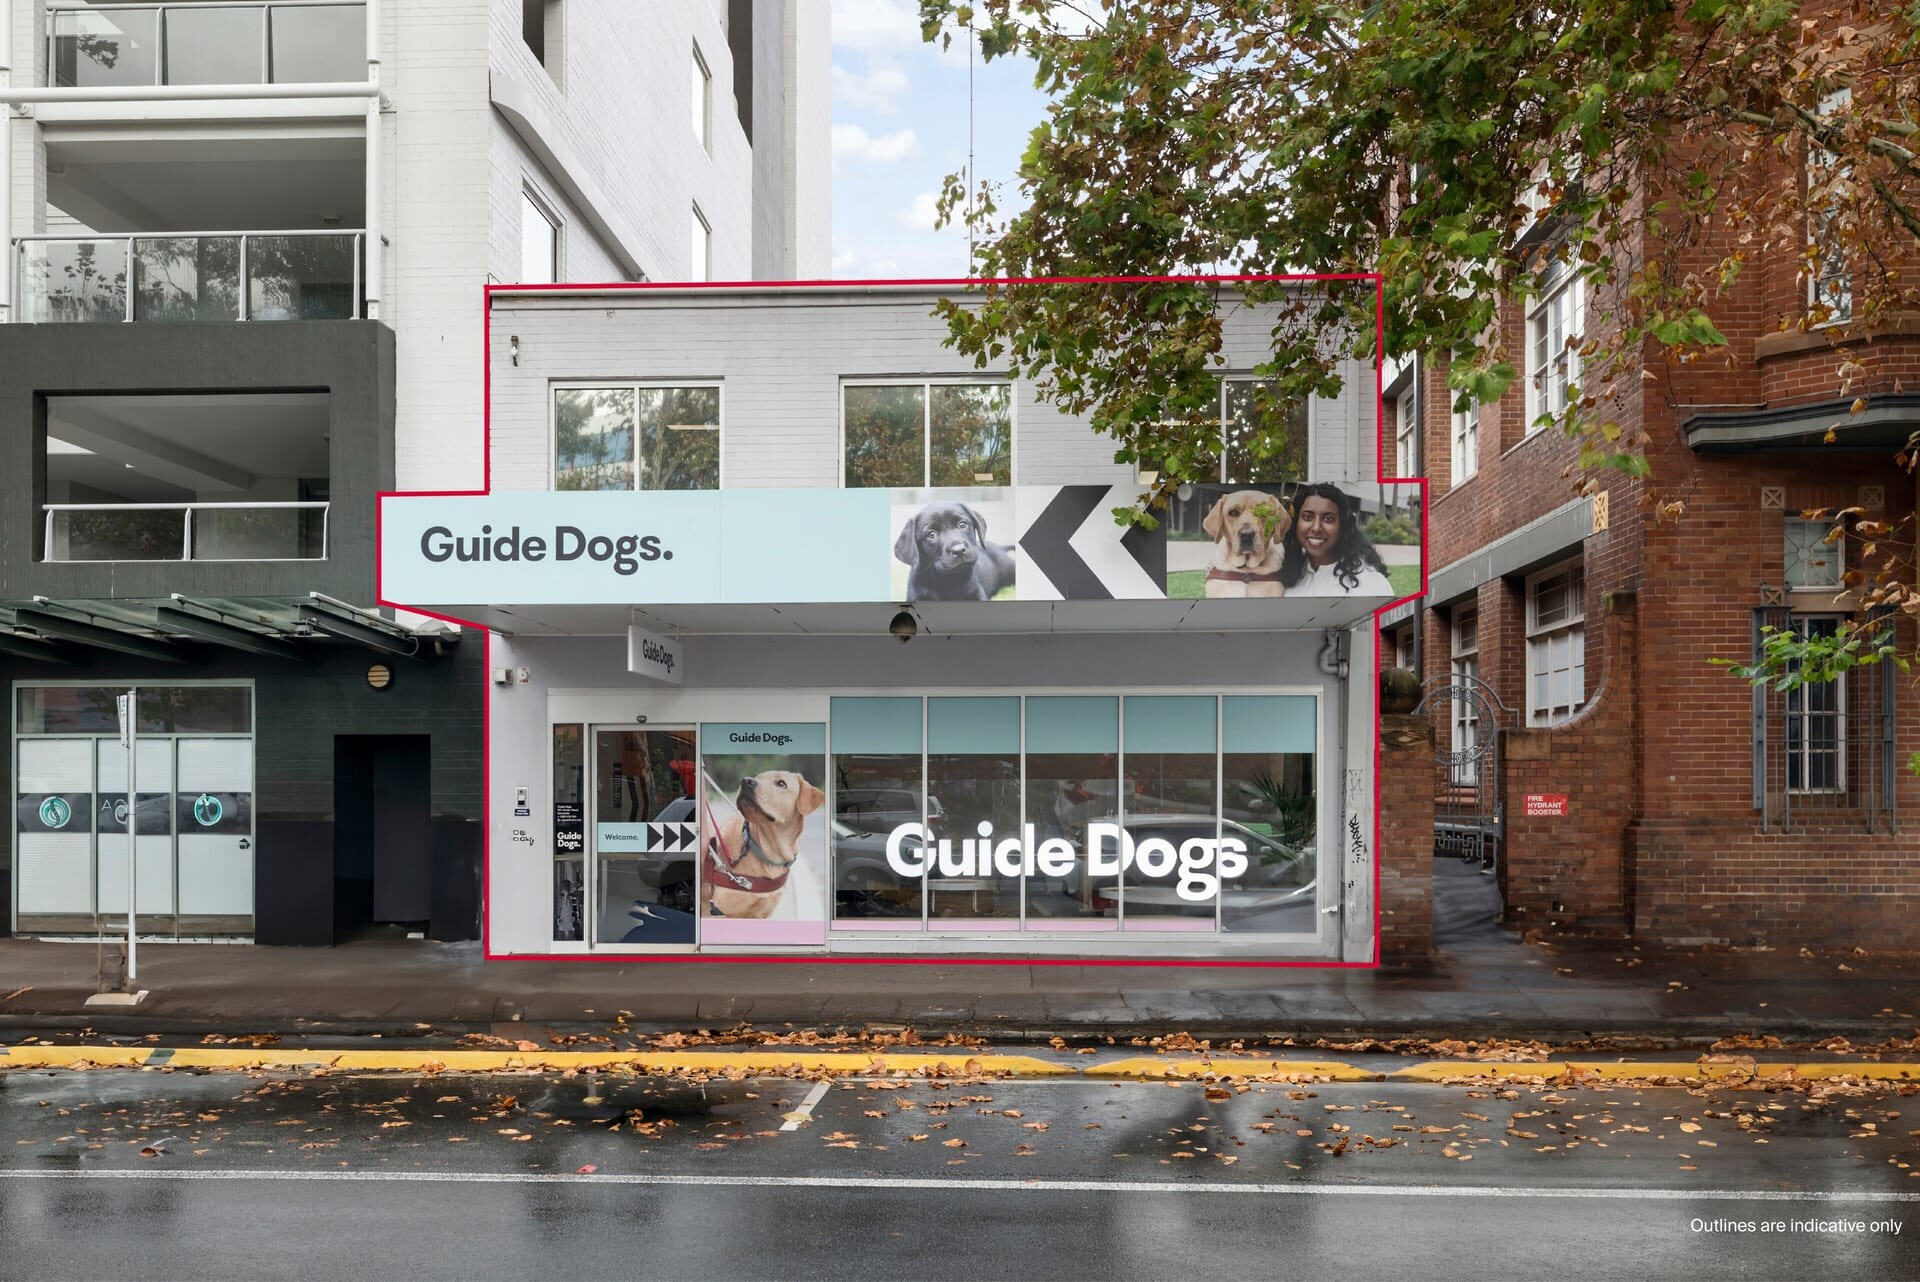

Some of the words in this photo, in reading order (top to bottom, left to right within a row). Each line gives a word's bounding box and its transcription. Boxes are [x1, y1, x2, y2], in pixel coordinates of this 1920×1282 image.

[421, 525, 547, 562] Guide
[555, 525, 673, 576] Dogs.
[642, 638, 660, 662] Guide
[660, 644, 675, 673] Dogs.
[729, 732, 761, 743] Guide
[763, 732, 793, 746] Dogs.
[557, 831, 582, 840] Guide
[605, 833, 639, 841] Welcome.
[557, 839, 581, 850] Dogs.
[885, 820, 1076, 878] Guide
[1087, 822, 1249, 900] Dogs
